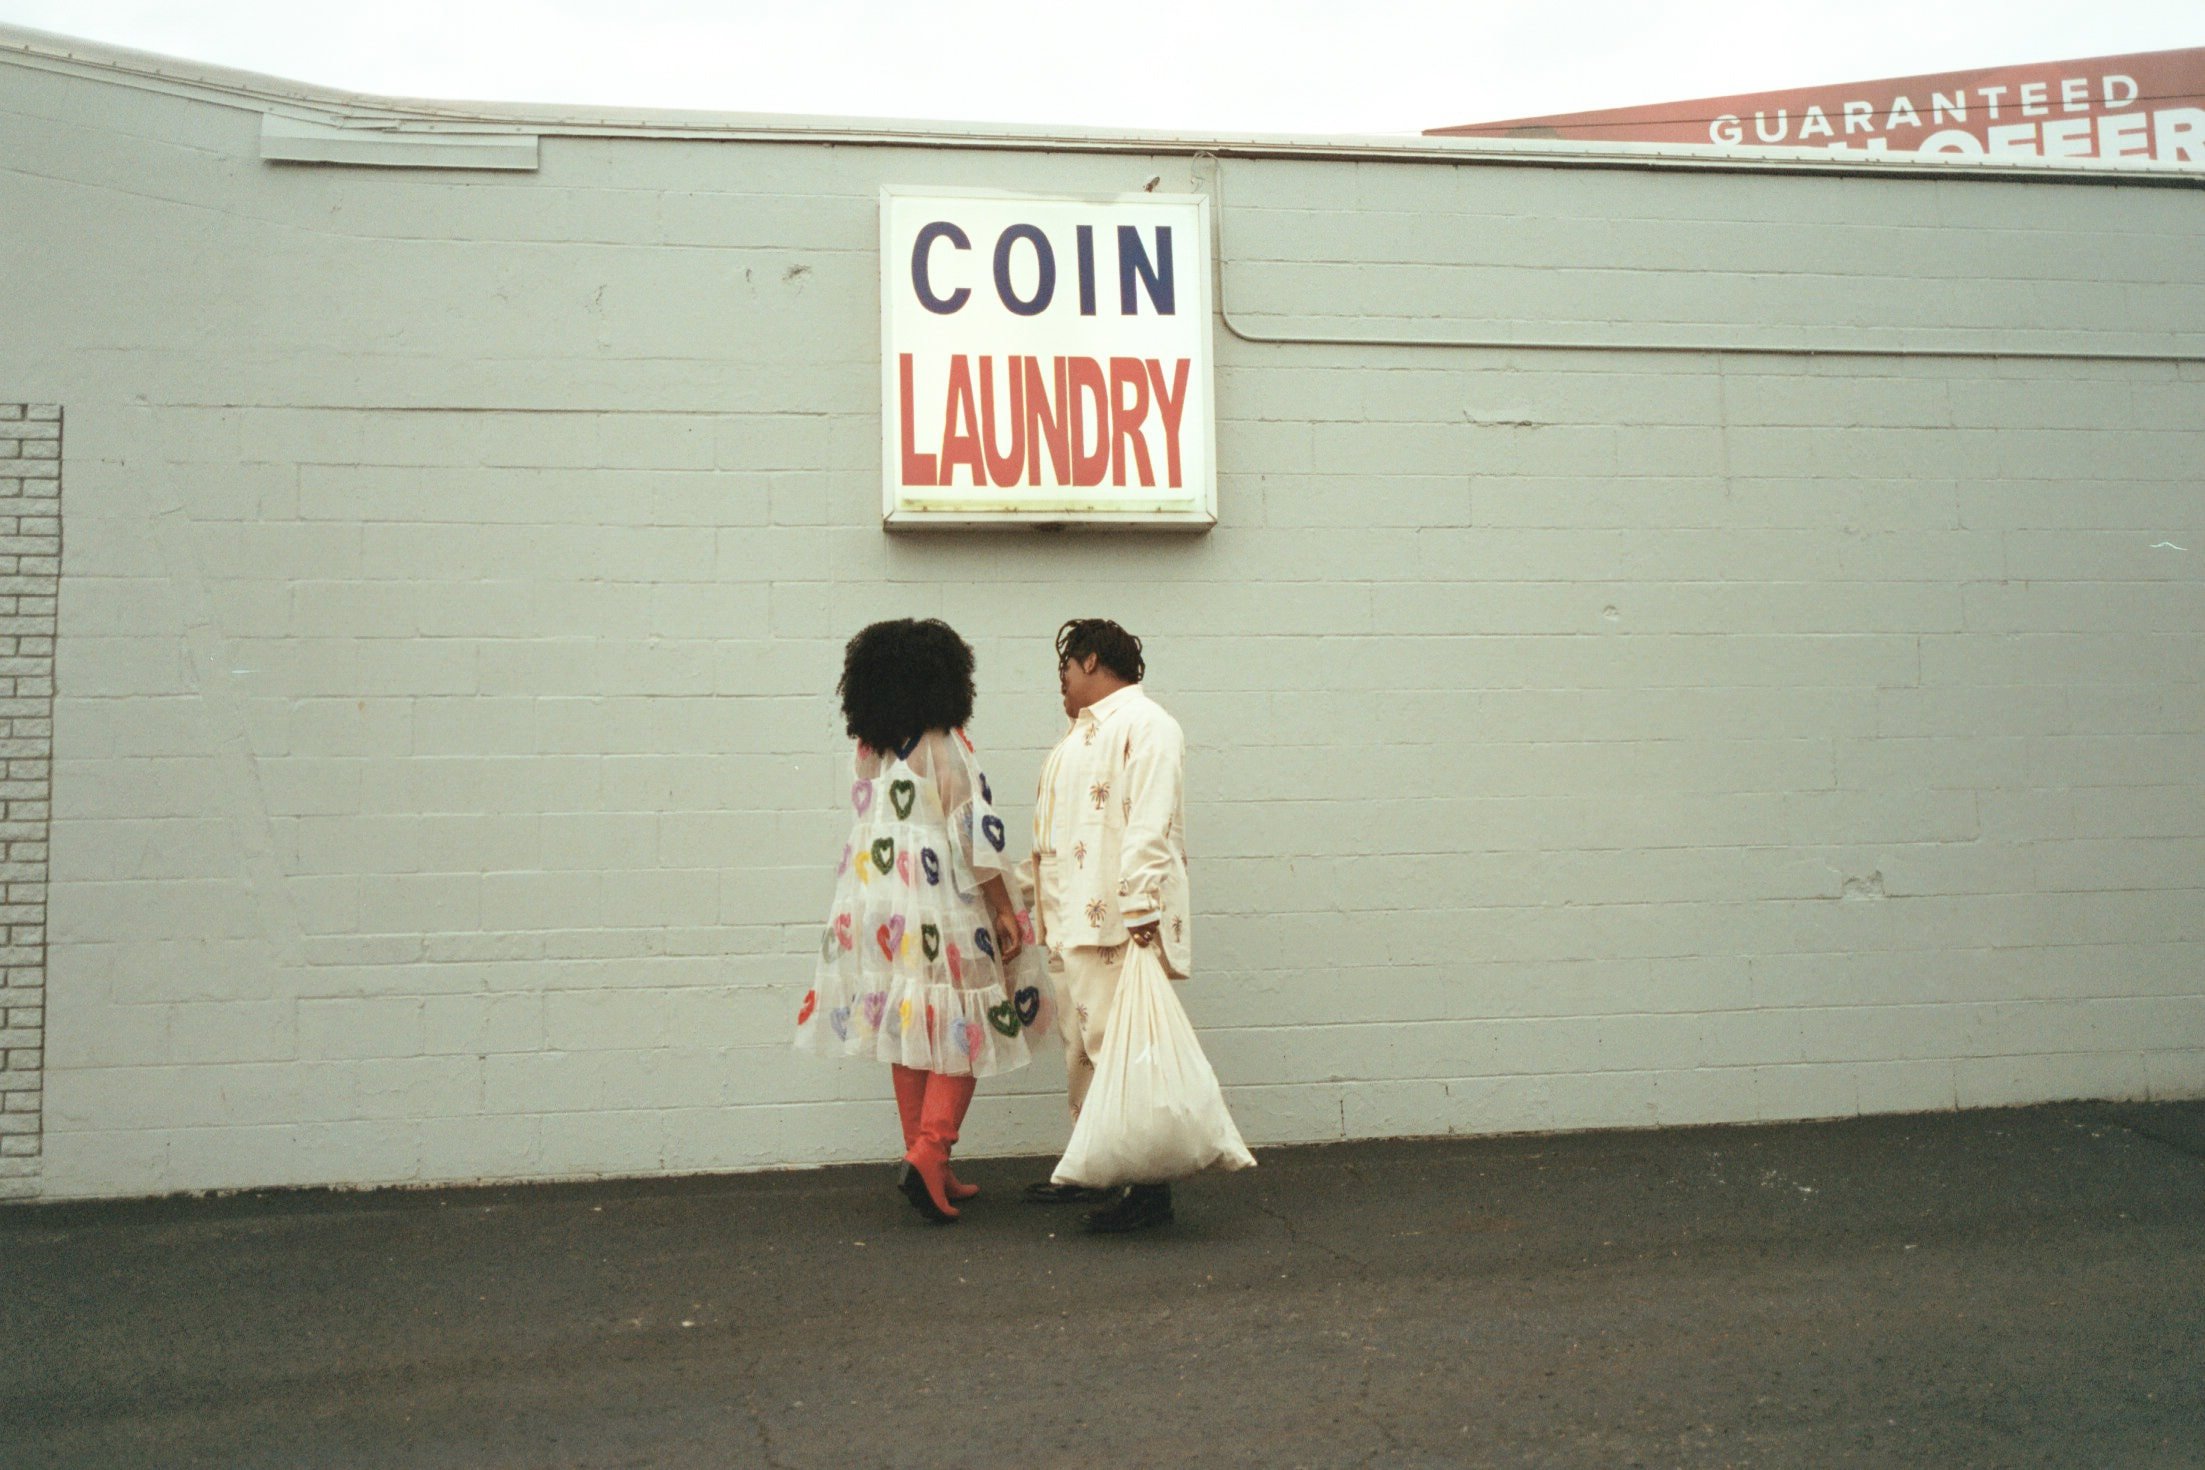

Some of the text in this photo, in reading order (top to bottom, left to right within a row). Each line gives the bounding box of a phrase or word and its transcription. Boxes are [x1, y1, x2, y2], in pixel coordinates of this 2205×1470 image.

[1709, 75, 2138, 145] GUARANTEED
[911, 221, 1175, 316] COIN
[899, 353, 1191, 488] LAUNDRY
